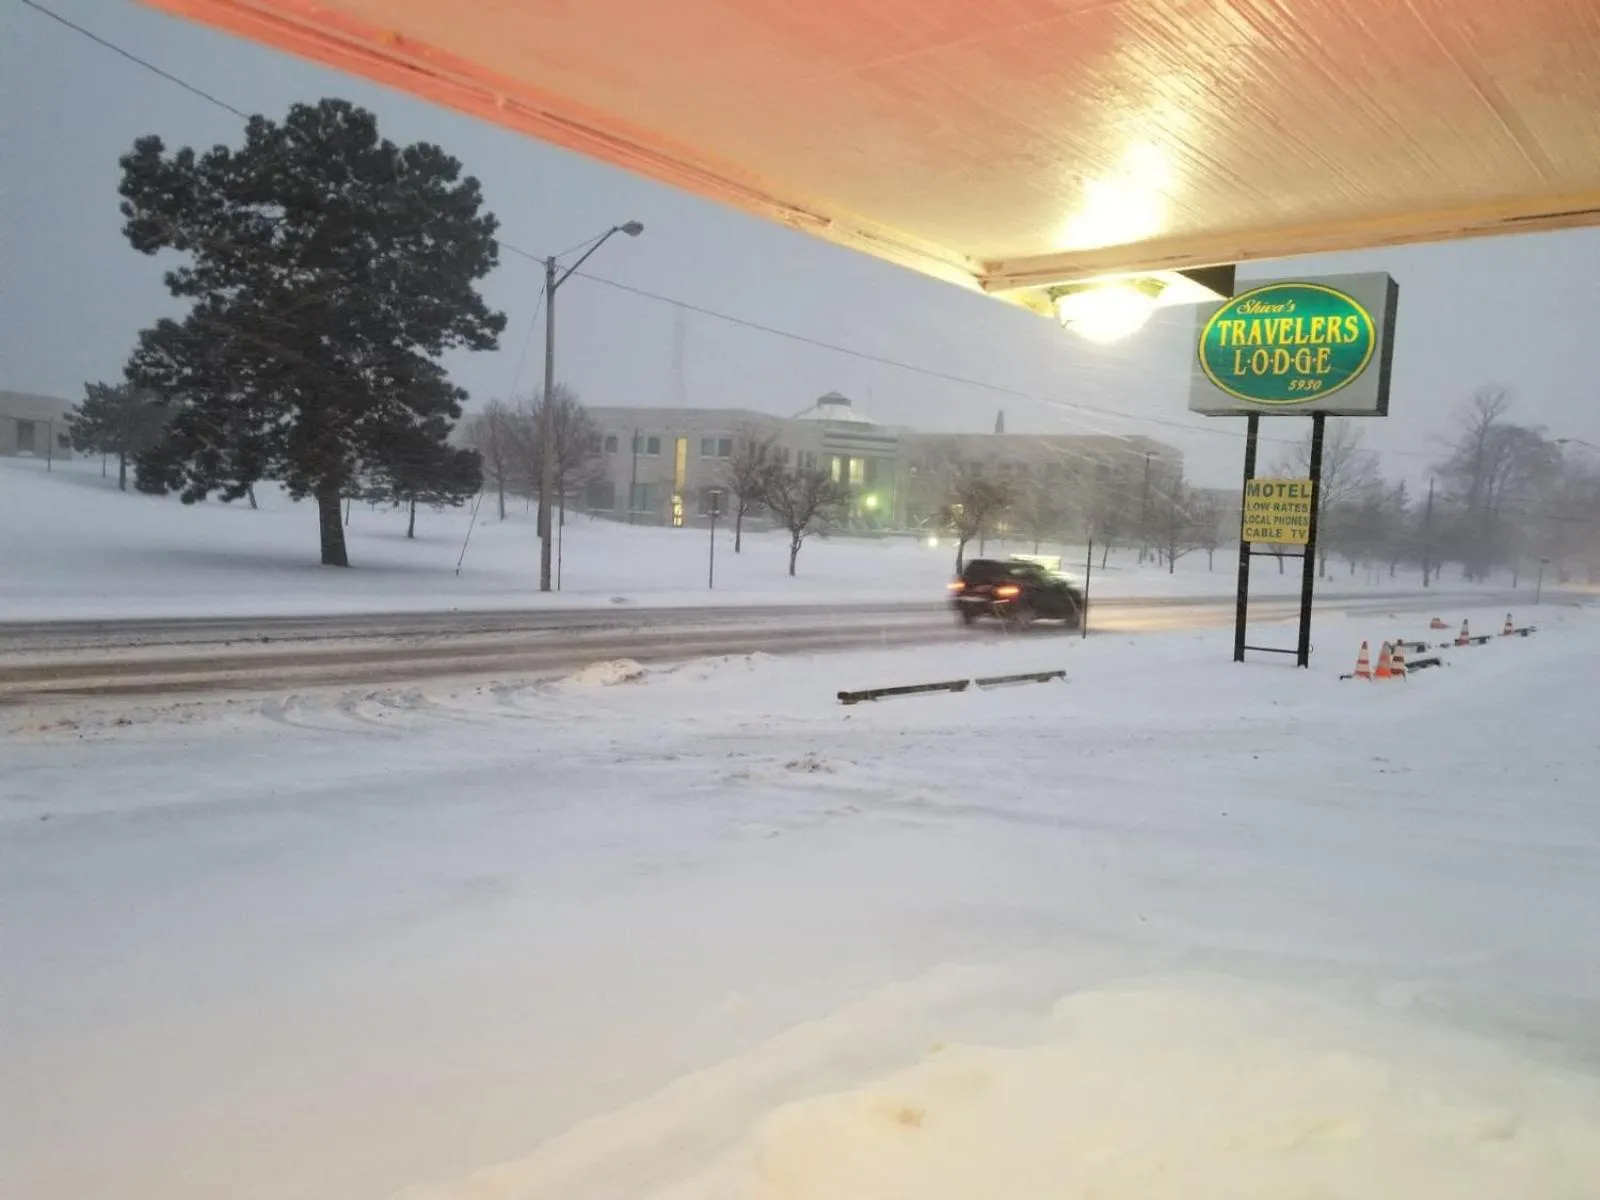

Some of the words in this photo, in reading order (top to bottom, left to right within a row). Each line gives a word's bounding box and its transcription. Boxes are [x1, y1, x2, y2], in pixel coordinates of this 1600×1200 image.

[1236, 299, 1296, 315] Shiva's
[1217, 315, 1360, 347] TRAVELERS
[1288, 379, 1322, 391] 5930
[1247, 483, 1310, 498] MOTEL
[1247, 502, 1270, 512] LOW
[1274, 503, 1308, 513] RATES
[1245, 514, 1271, 525] LOCAL
[1274, 515, 1309, 526] PHONES
[1245, 527, 1282, 538] CABLE
[1291, 529, 1307, 538] TV
